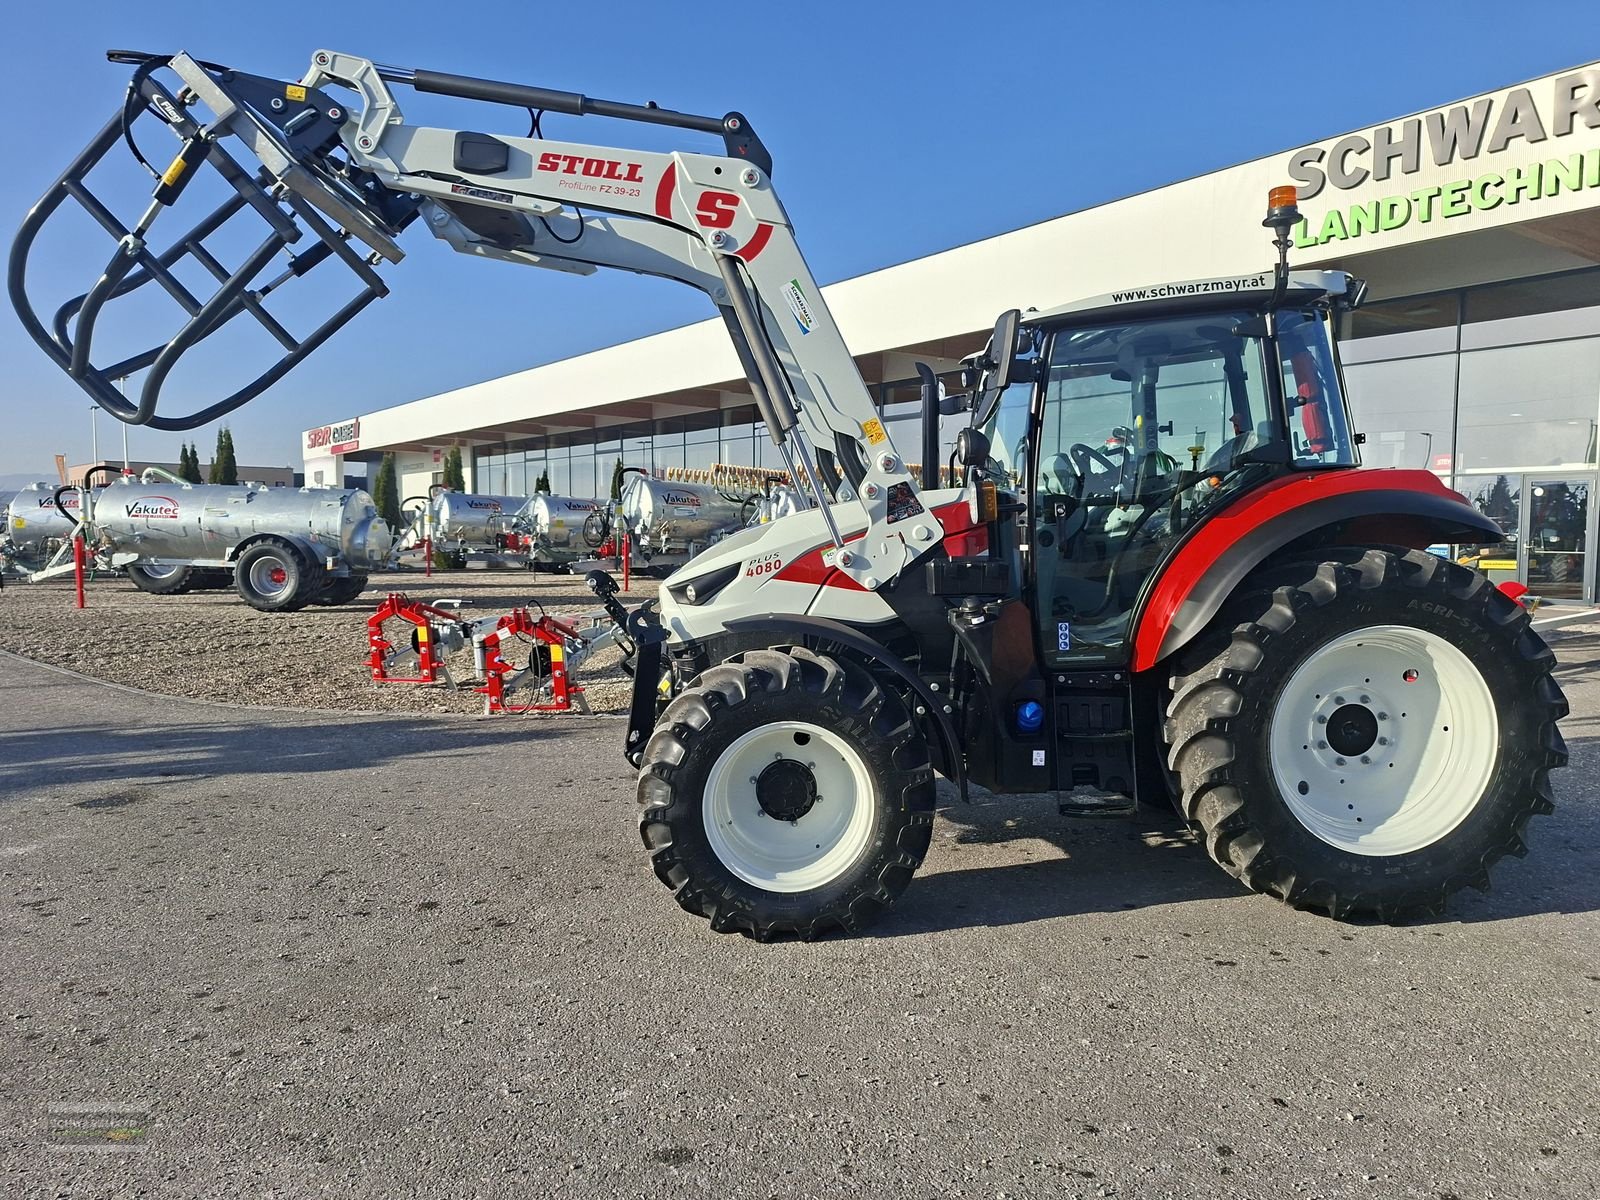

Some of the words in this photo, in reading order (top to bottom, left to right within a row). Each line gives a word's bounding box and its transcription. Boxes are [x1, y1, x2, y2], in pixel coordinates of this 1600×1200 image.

[1288, 70, 1600, 200] SCHWAR
[537, 152, 644, 183] STOLL
[558, 179, 598, 193] ProfiLine
[599, 184, 612, 194] FZ
[613, 186, 641, 198] 39-23
[695, 190, 740, 229] S
[1111, 275, 1266, 303] www.schwarzmayr.at
[661, 492, 701, 505] Vakutec
[125, 501, 179, 517] Vakutec
[749, 551, 780, 566] PLUS
[746, 559, 783, 578] 4080
